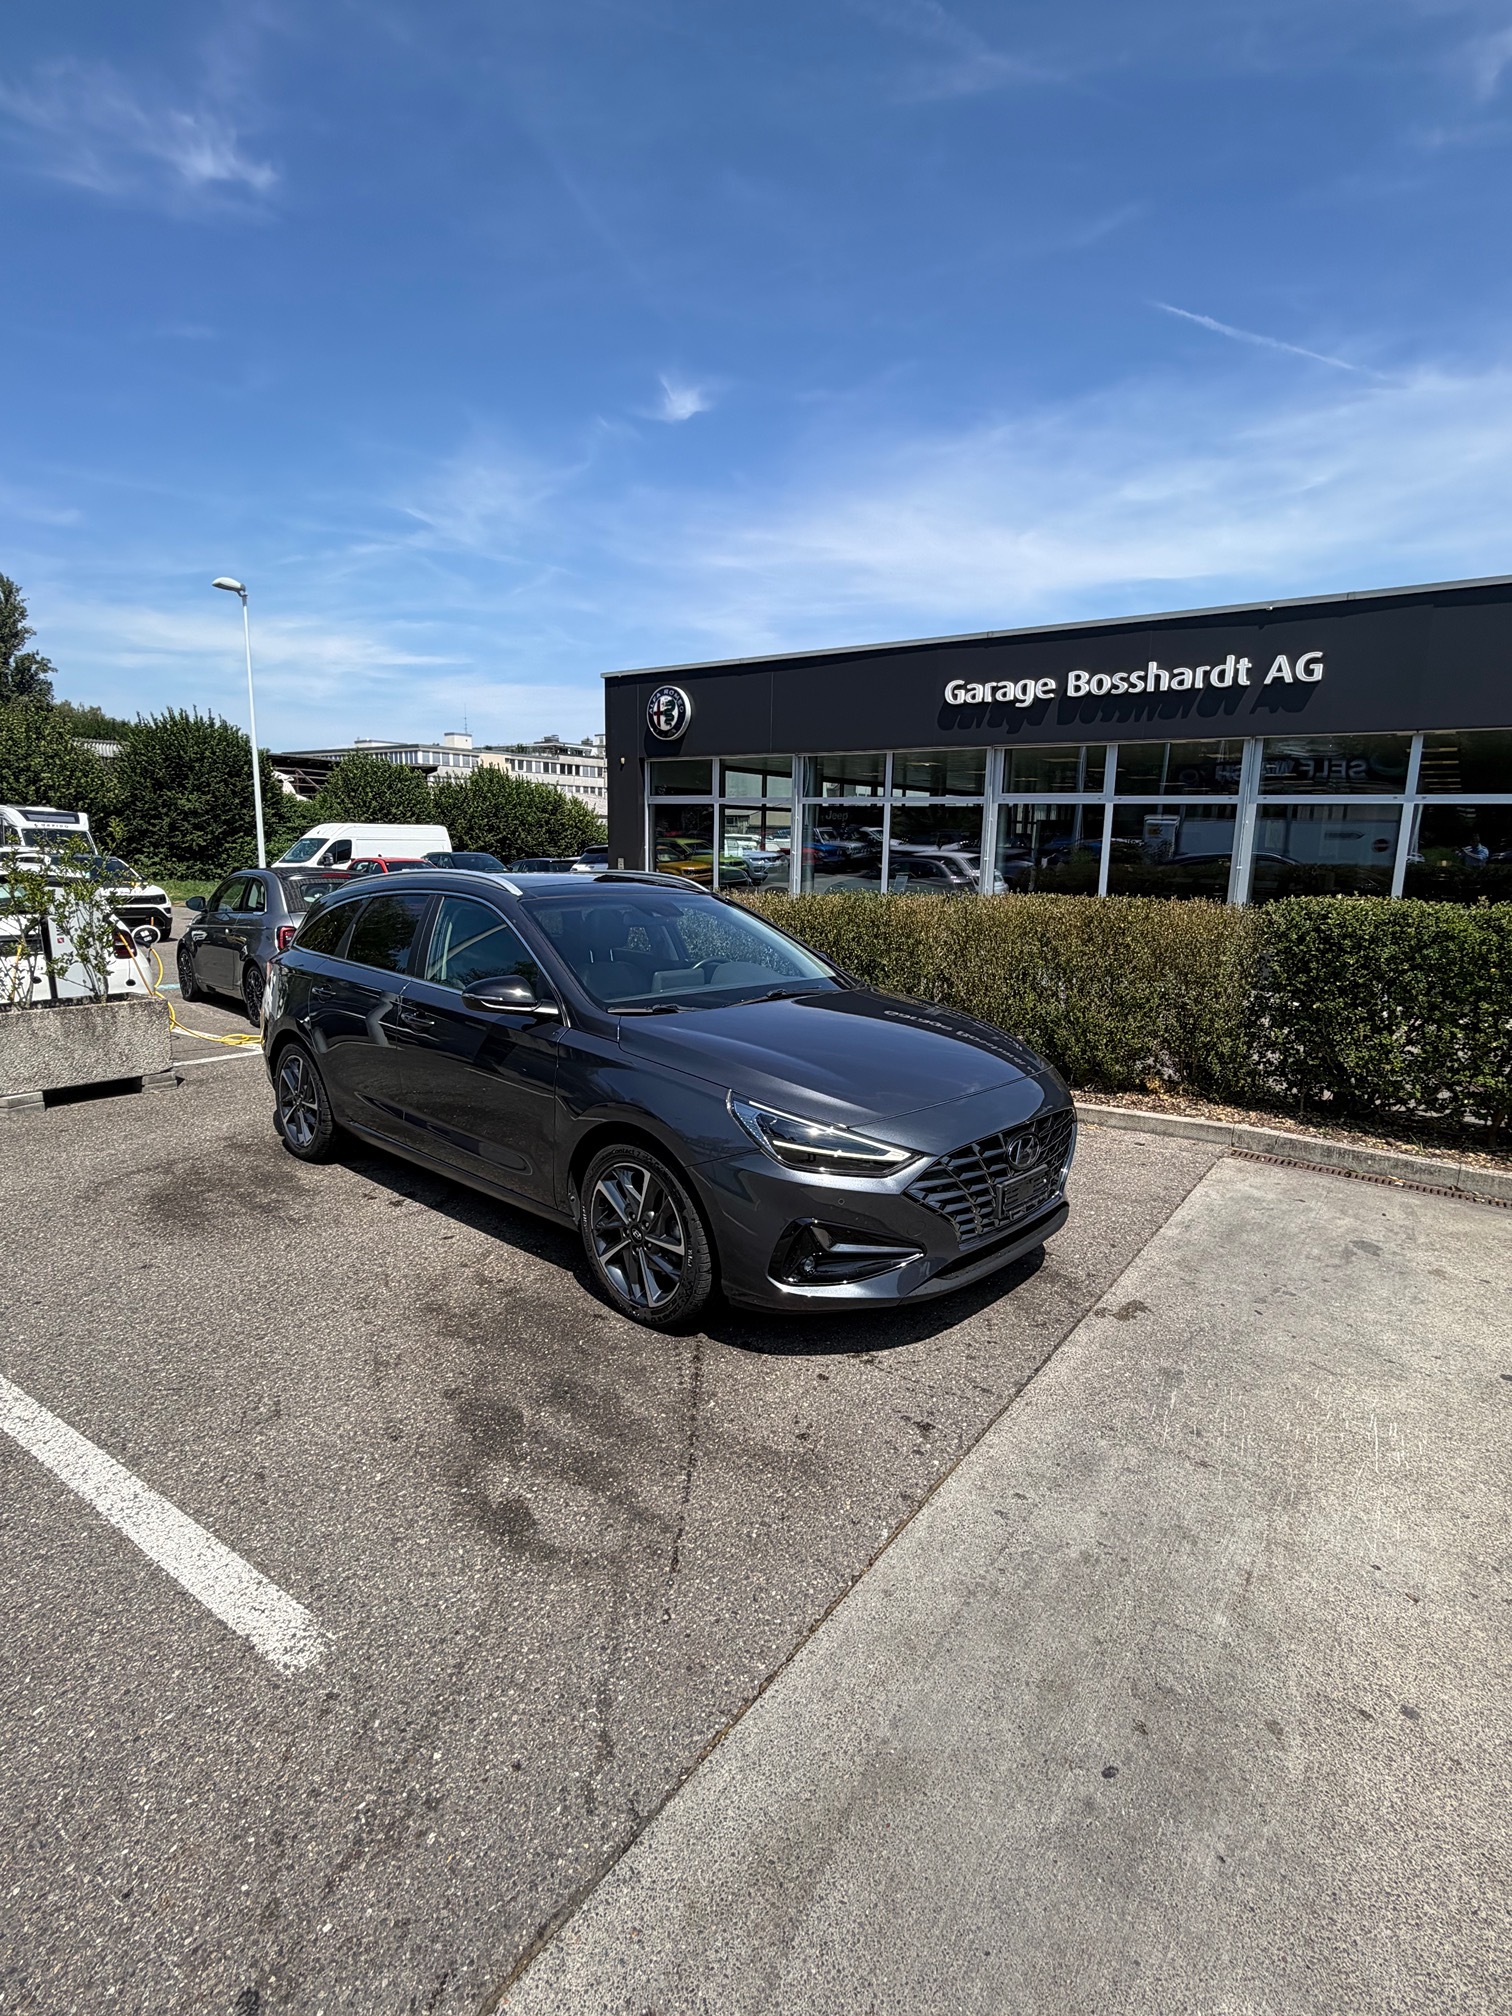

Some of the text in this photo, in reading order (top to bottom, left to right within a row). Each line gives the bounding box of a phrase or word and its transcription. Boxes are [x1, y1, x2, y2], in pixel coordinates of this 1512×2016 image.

[944, 652, 1324, 707] Garage Bosshardt AG
[648, 689, 684, 715] ALFA ROMEO
[826, 811, 848, 822] Jeep
